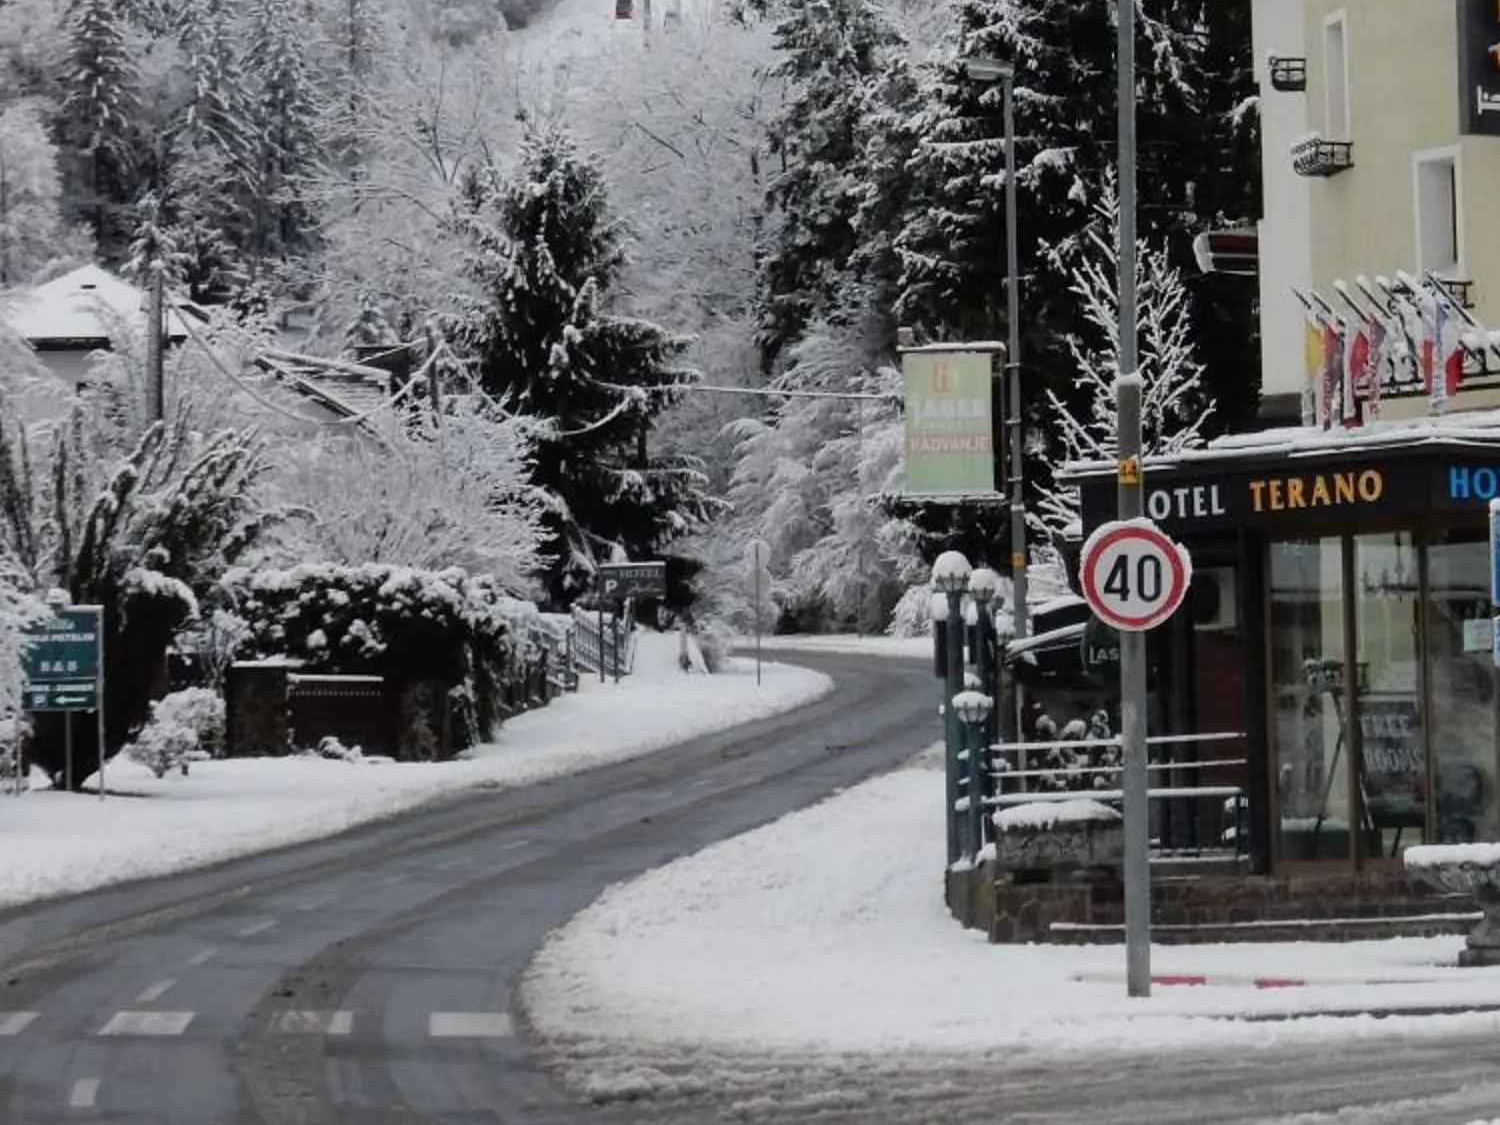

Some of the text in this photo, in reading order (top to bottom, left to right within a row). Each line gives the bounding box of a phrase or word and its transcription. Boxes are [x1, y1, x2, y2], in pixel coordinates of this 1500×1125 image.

[1147, 470, 1384, 520] OTEL TERANO
[1103, 554, 1162, 602] 40
